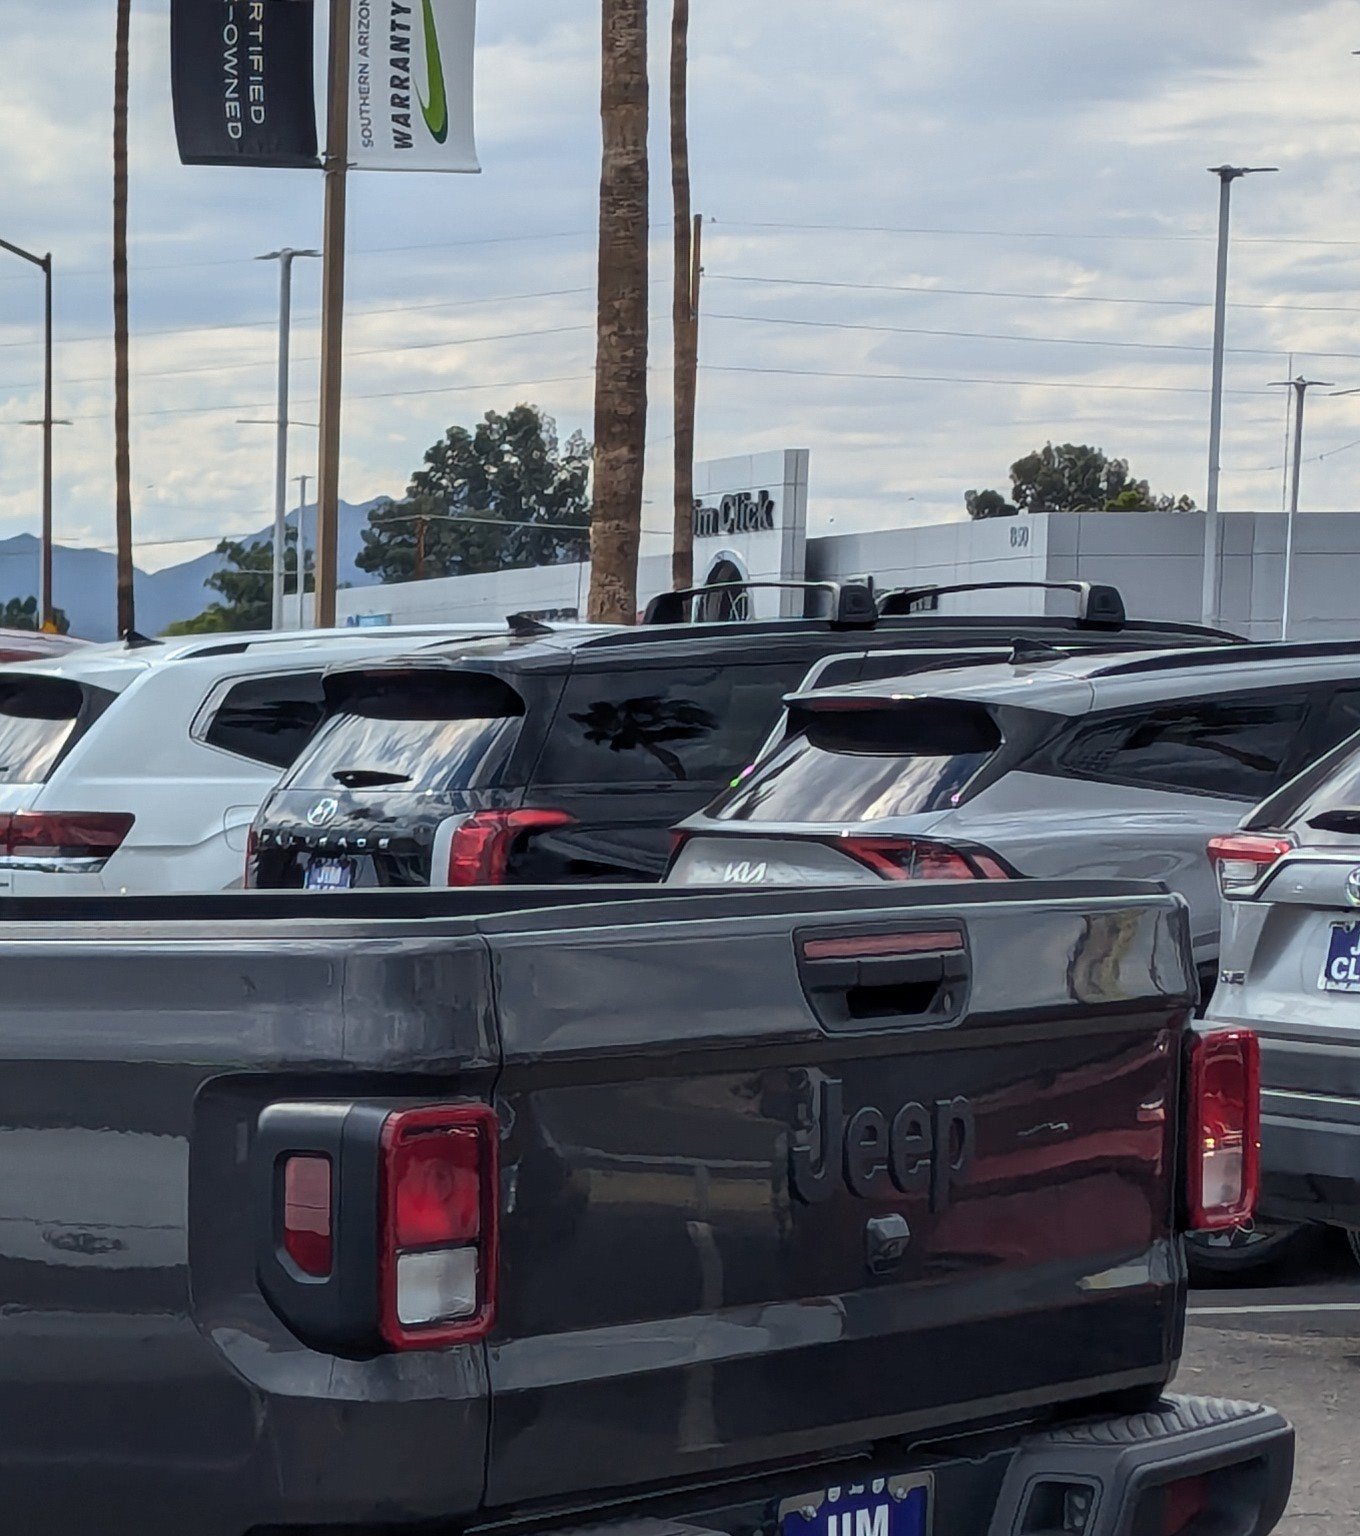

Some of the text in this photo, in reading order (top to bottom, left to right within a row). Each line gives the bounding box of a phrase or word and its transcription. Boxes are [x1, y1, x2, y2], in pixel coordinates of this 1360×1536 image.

[223, 0, 242, 139] -OWNED
[248, 1, 265, 124] RTIFIED
[357, 63, 374, 148] SOUTHERN
[389, 1, 413, 149] WARRANTY
[719, 489, 775, 535] Click
[788, 1078, 977, 1214] Jeep
